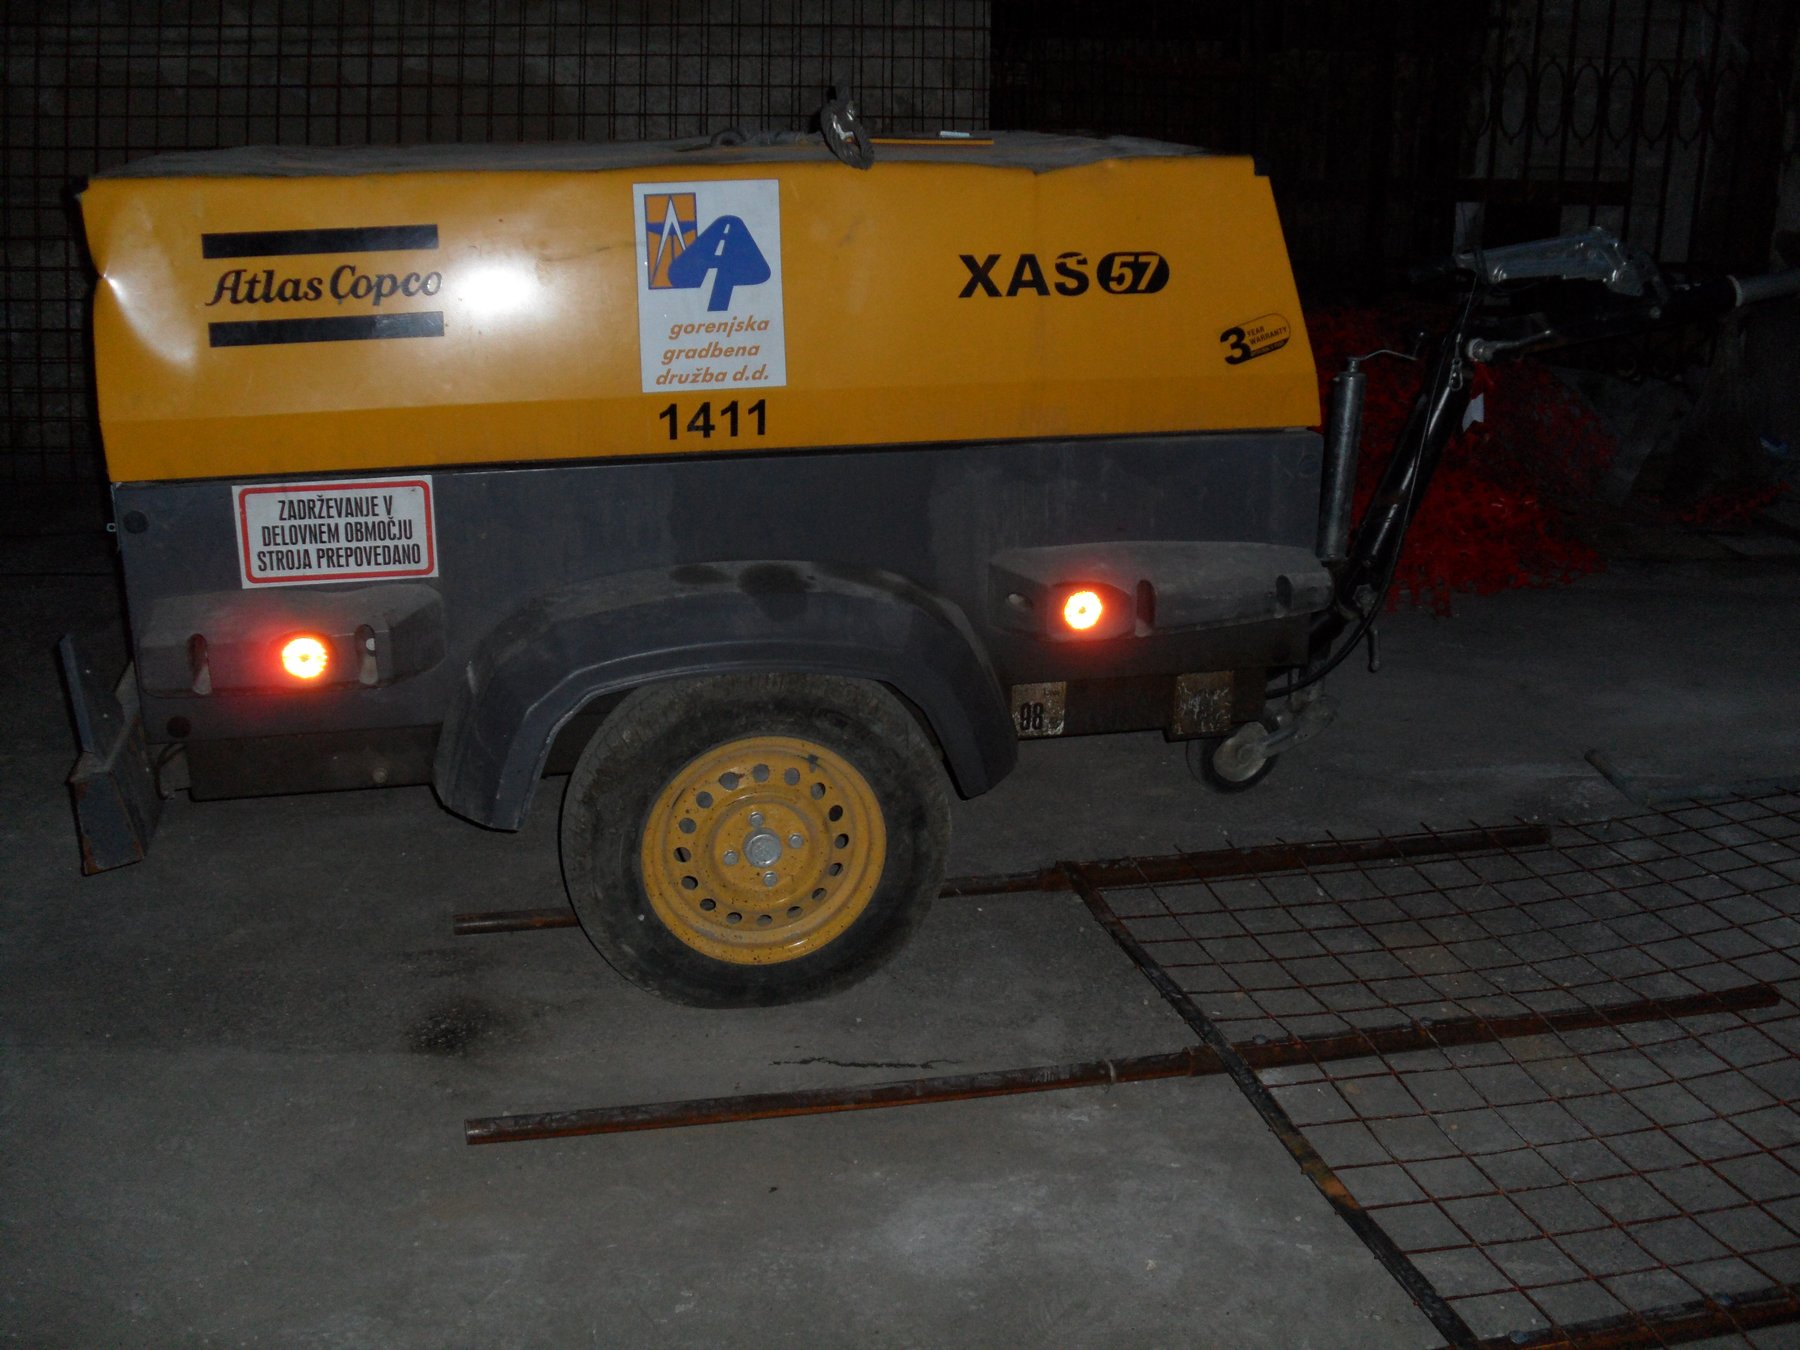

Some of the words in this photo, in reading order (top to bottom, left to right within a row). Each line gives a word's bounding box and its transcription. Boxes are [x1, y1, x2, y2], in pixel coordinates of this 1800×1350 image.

[205, 268, 323, 306] Atlas
[329, 264, 442, 306] Copco
[958, 252, 1090, 298] XAS
[1108, 254, 1160, 293] 57
[668, 314, 770, 340] gorenjska
[1249, 327, 1288, 345] WARRANTY
[661, 341, 760, 365] gradbena
[1220, 327, 1251, 365] 3
[1247, 326, 1265, 337] YEAR
[656, 367, 728, 386] družba
[732, 364, 769, 382] d.d.
[659, 399, 766, 440] 1411
[278, 494, 379, 521] ZADRŽEVANJE
[383, 495, 393, 516] V
[261, 522, 340, 547] DELOVNEM
[345, 517, 413, 542] OBMOČJU
[257, 549, 312, 572] STROJA
[317, 543, 421, 569] PREPOVEDANO
